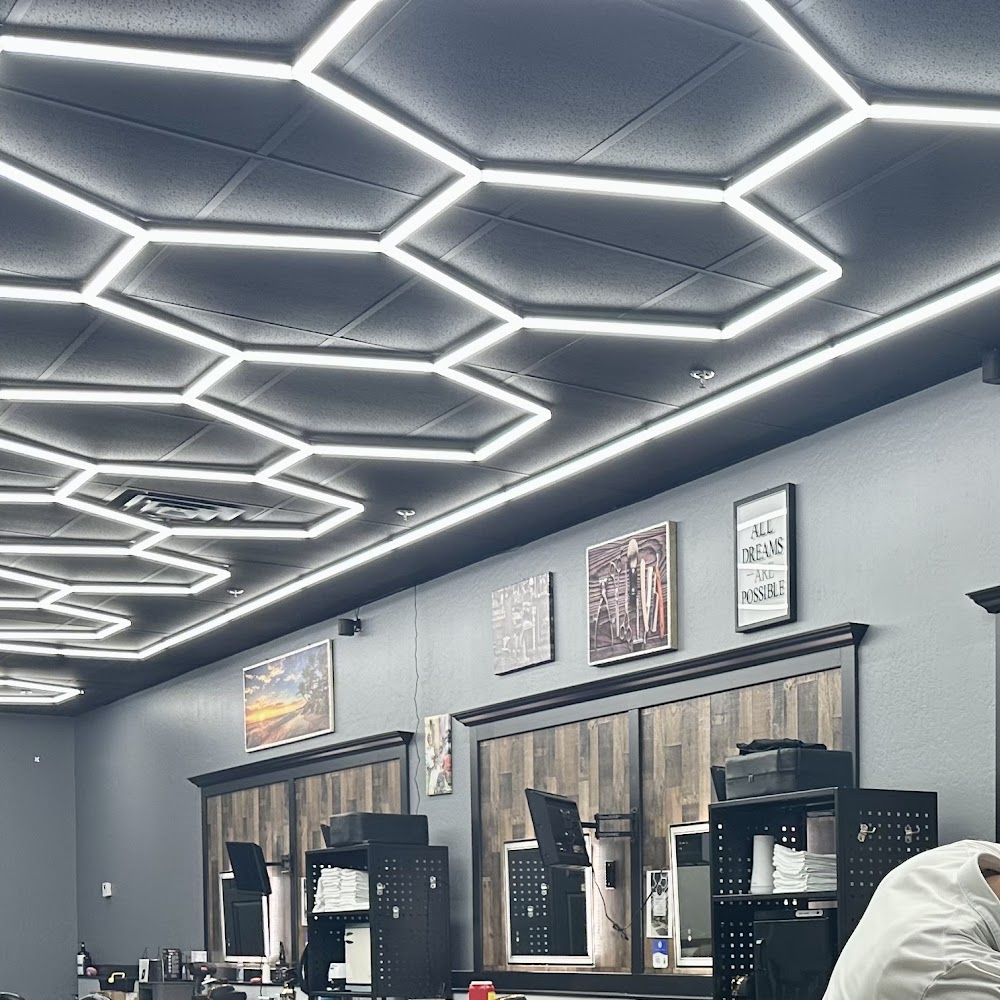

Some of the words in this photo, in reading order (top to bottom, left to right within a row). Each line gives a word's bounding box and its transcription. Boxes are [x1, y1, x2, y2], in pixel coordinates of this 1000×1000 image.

[750, 519, 775, 540] ALL
[742, 536, 784, 564] DREAMS
[741, 579, 785, 605] POSSIBLE
